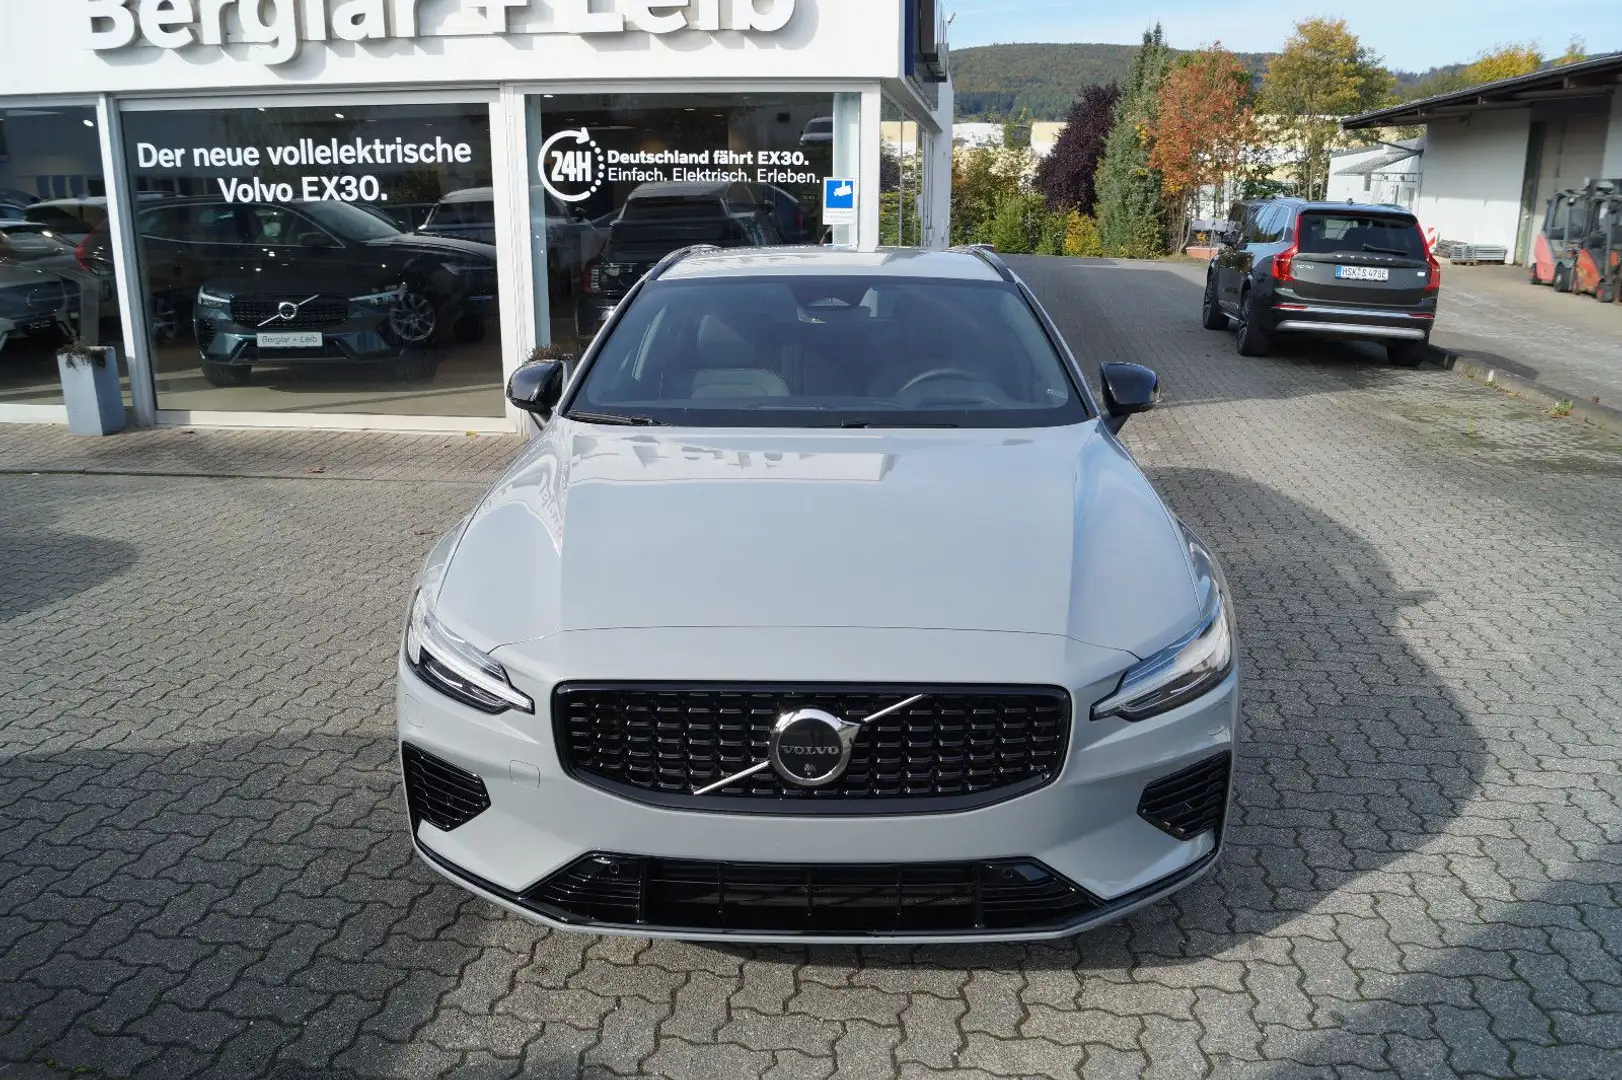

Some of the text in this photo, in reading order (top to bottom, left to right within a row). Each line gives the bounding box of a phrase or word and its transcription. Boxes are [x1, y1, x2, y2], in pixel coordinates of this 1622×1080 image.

[83, 0, 417, 65] Berglar
[137, 136, 472, 168] Der neue vollelektrische
[607, 150, 810, 166] Deutschland fährt EX30.
[551, 151, 592, 183] 24H
[608, 167, 821, 183] Einfach. Elektrisch. Erleben.
[218, 175, 388, 203] Volvo EX30.
[262, 336, 290, 345] Berglar
[300, 335, 318, 343] Leib
[780, 745, 840, 755] VOLVO
